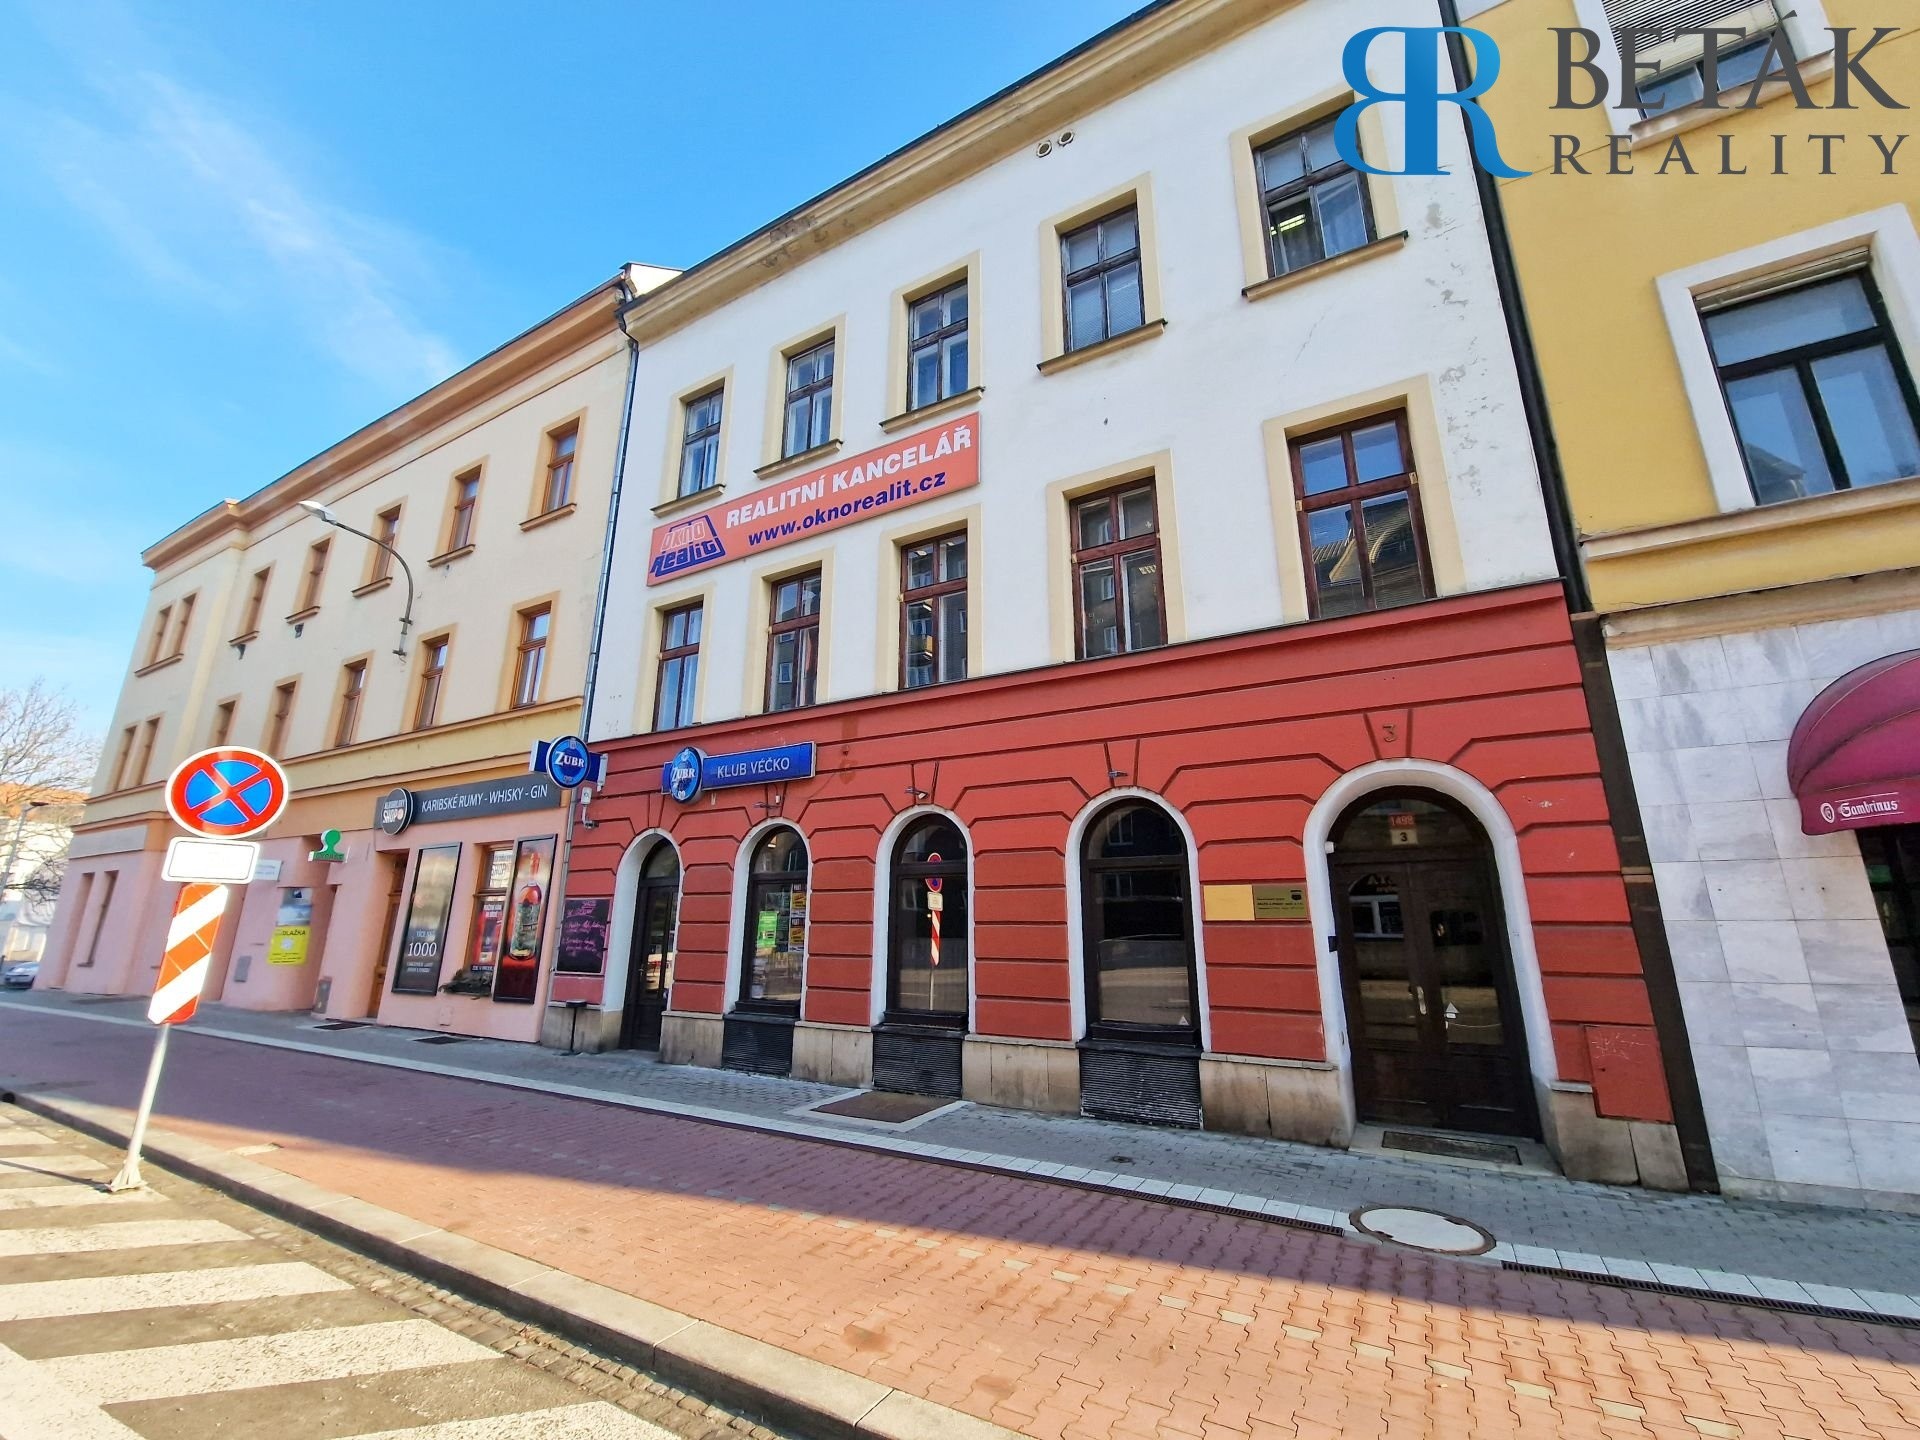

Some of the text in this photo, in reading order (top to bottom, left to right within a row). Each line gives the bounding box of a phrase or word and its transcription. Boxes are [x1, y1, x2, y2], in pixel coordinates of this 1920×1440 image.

[726, 424, 971, 528] REALITNÍ KANCELÁŘ
[748, 471, 946, 546] www.oknorealit.cz
[1382, 723, 1398, 742] 3
[554, 750, 585, 768] ZUBR
[717, 756, 790, 779] KLUB VÉČKO
[421, 793, 459, 813] KARIBSKÉ
[459, 793, 484, 808] RUMY
[489, 788, 525, 804] WHISKY
[530, 784, 548, 799] GIN
[1839, 800, 1898, 818] Gambrinus
[1400, 832, 1408, 842] 3
[407, 942, 437, 957] 1000
